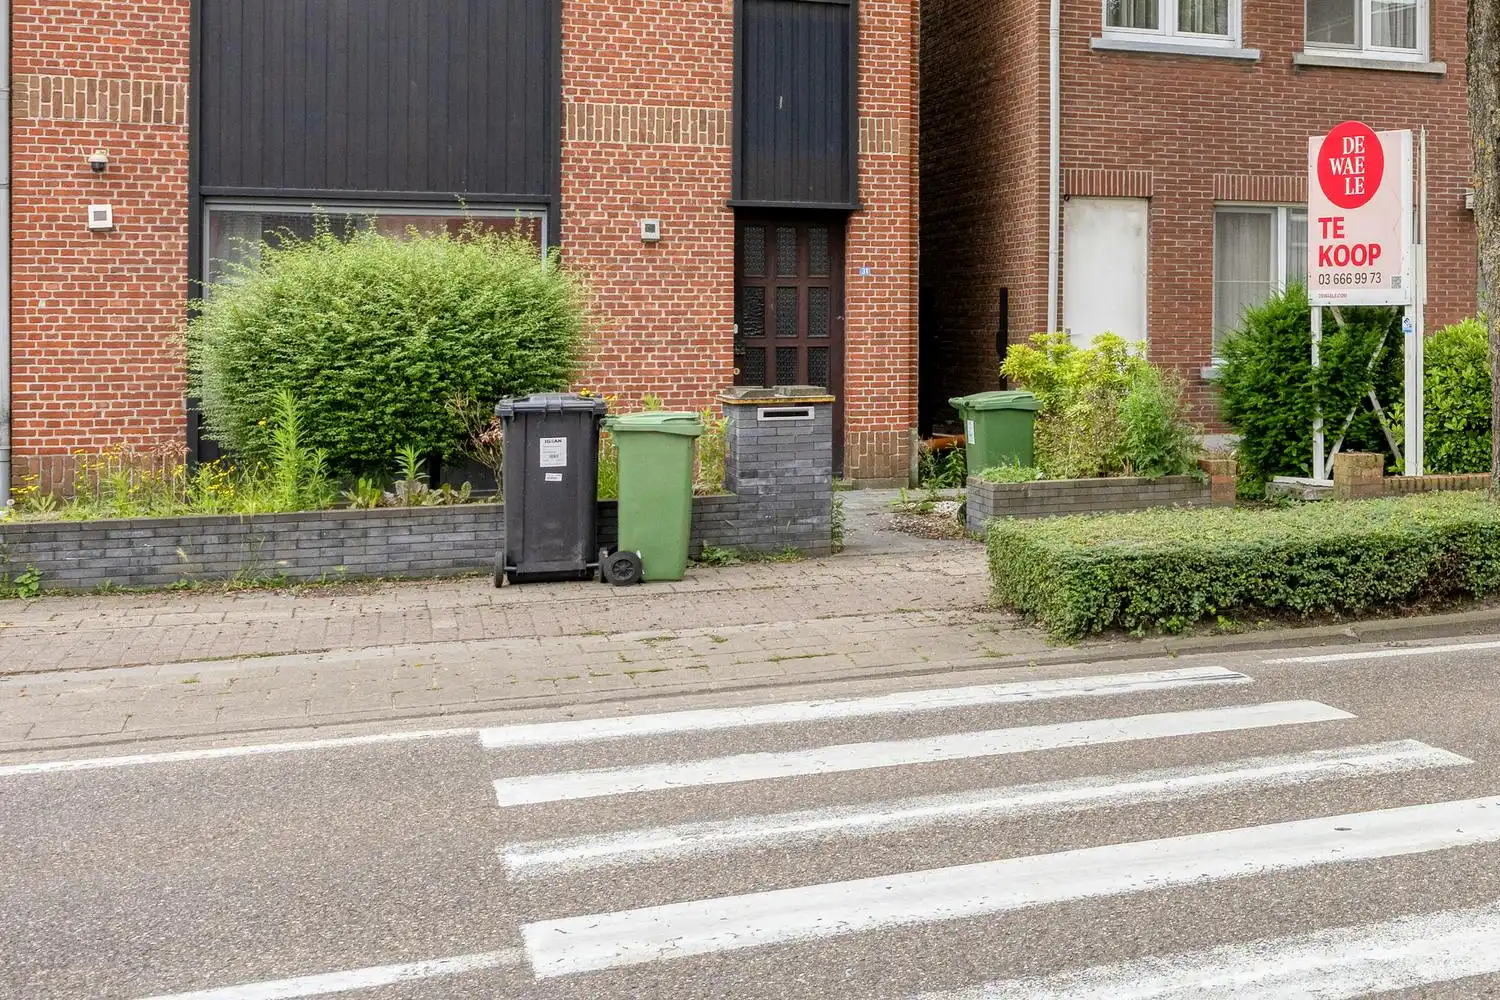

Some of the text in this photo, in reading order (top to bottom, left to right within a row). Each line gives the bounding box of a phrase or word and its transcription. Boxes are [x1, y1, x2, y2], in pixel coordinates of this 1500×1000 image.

[1343, 135, 1365, 155] DE
[1329, 156, 1365, 176] WAE
[1344, 177, 1365, 195] LE
[1318, 216, 1345, 239] TE
[1318, 243, 1381, 268] KOOP
[1318, 272, 1382, 285] 03 666 99 73
